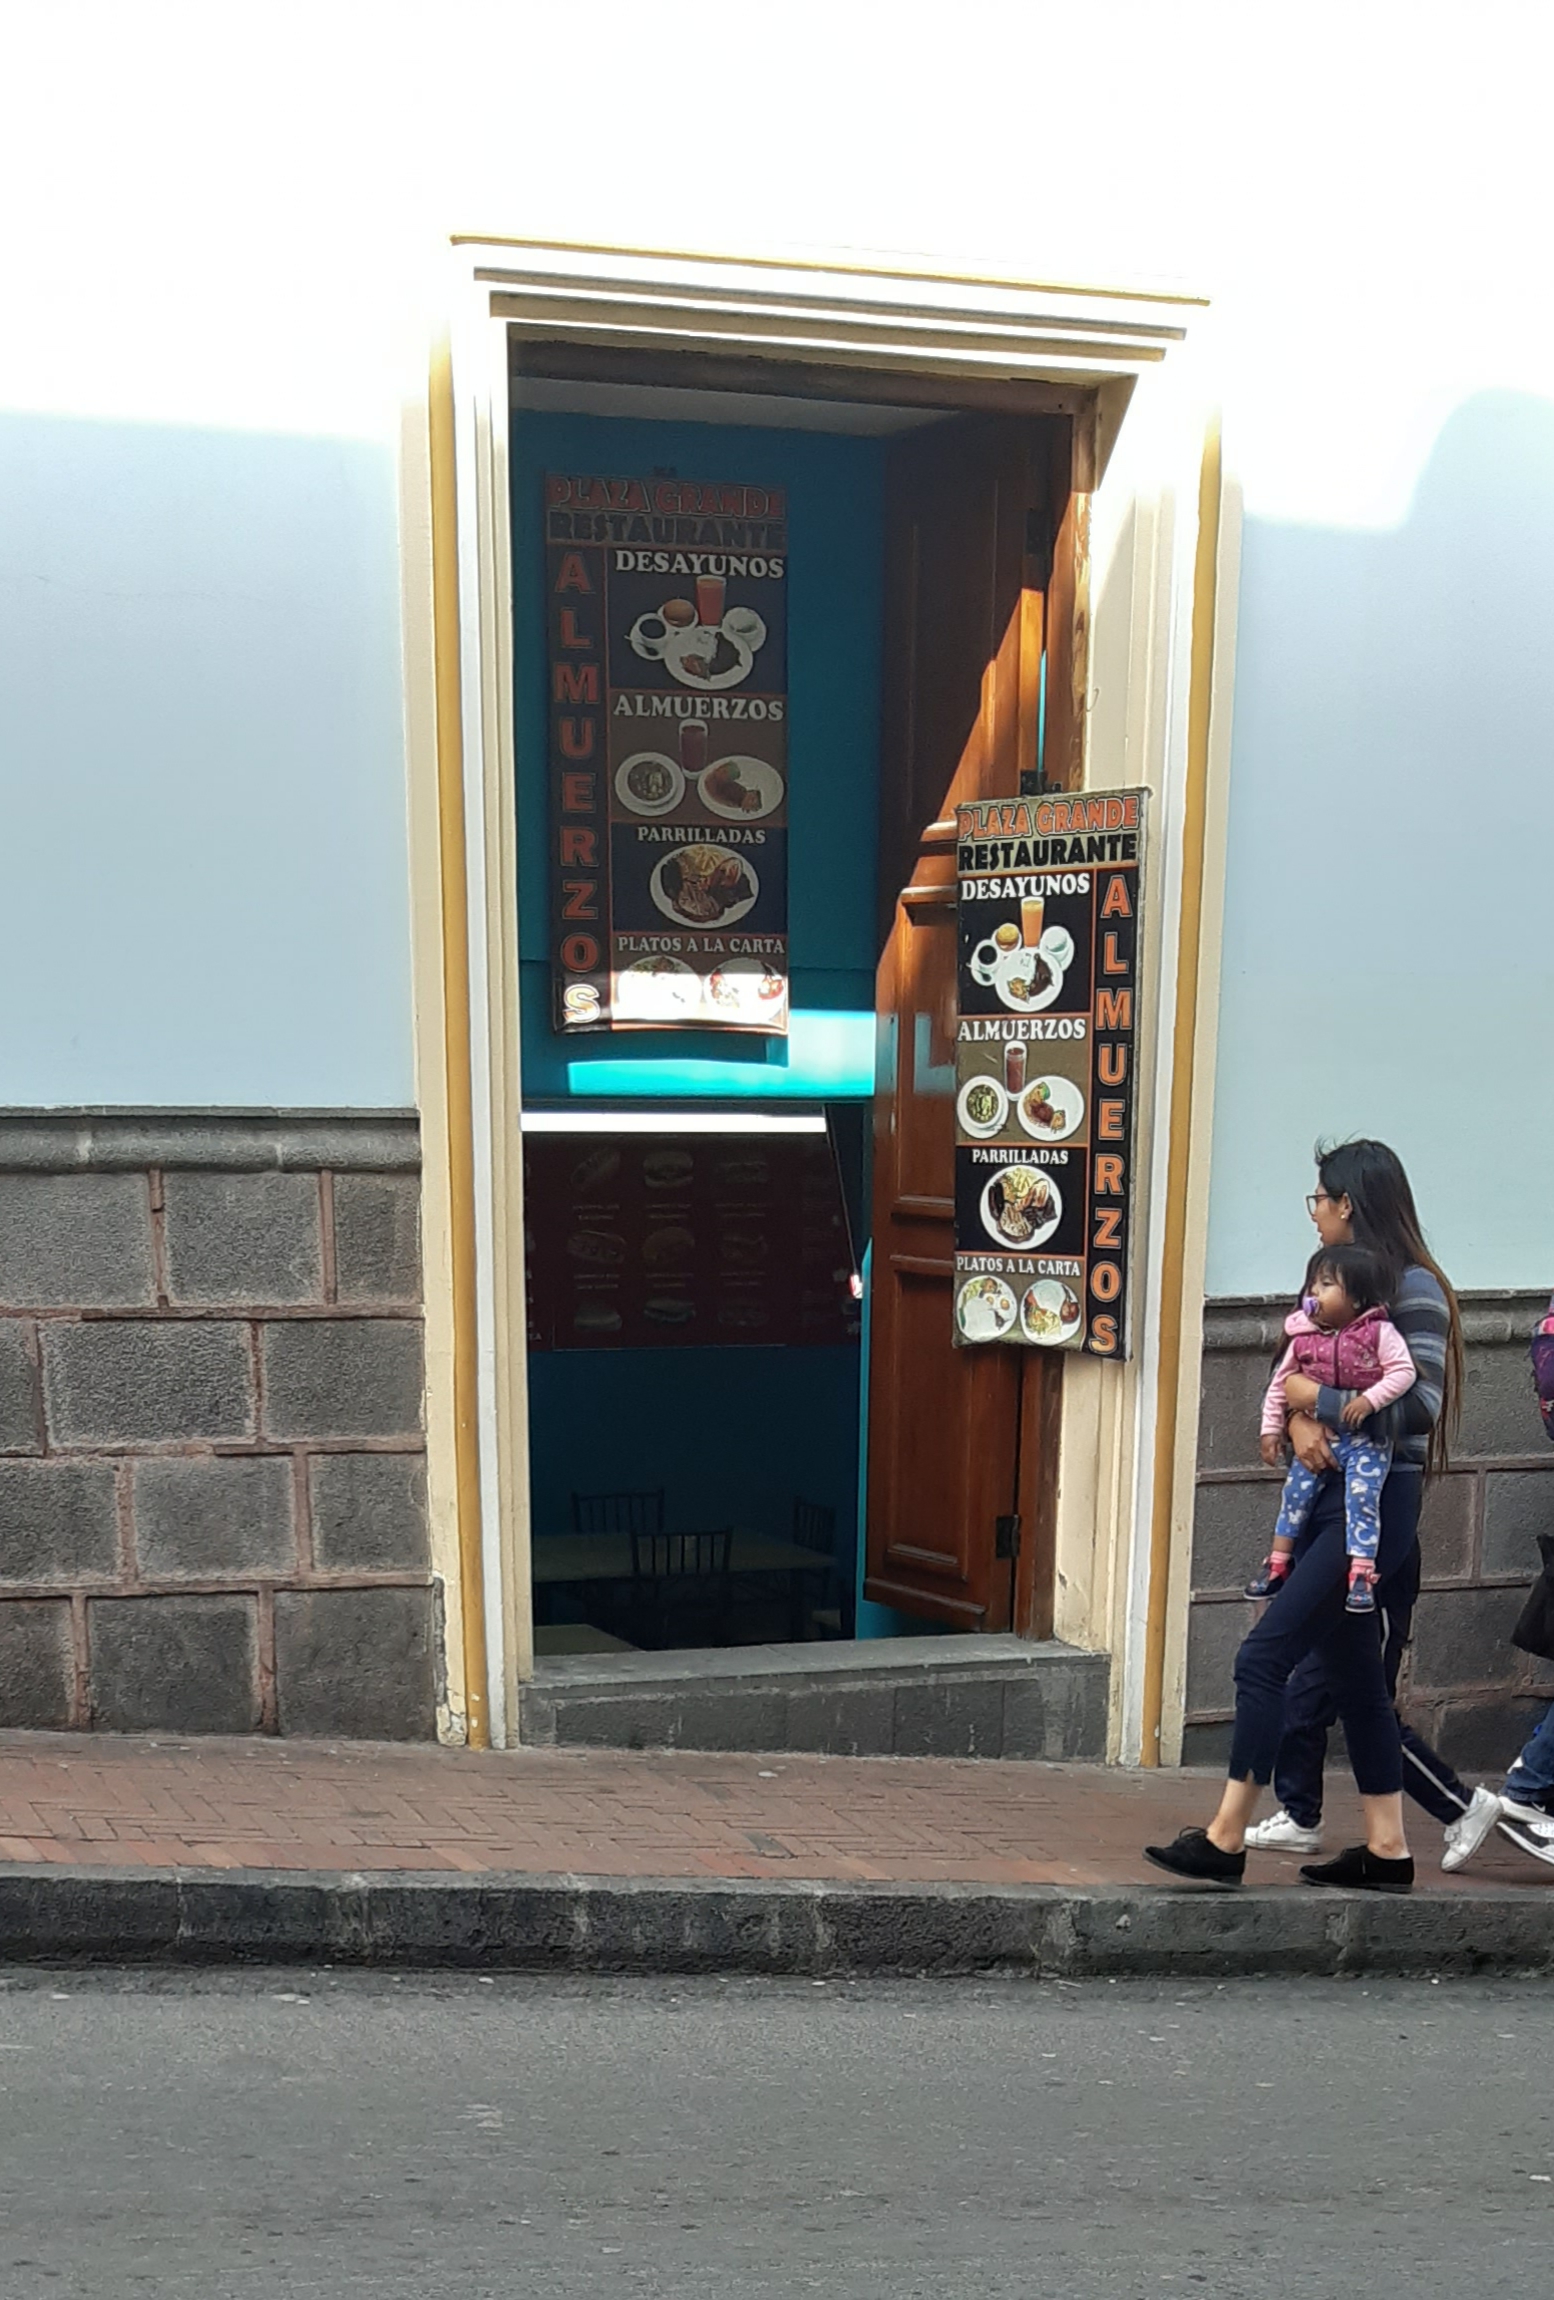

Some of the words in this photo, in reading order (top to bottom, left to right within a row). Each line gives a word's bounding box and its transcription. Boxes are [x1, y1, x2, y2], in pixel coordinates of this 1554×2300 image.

[549, 476, 650, 513] PLAZA
[655, 482, 786, 519] GRANDE
[549, 512, 788, 548] RESTAURANTE
[616, 550, 785, 578] DESAYUNOS
[613, 694, 785, 721] ALMUERZOS
[554, 552, 601, 1022] ALMUERZOS
[958, 804, 1032, 842] PLAZA
[1036, 795, 1139, 837] GRANDE
[637, 826, 766, 844] PARRILLADAS
[958, 833, 1138, 871] RESTAURANTE
[961, 873, 1090, 901] DESAYUNOS
[617, 936, 682, 952] PLATOS
[686, 937, 699, 952] A
[703, 938, 725, 952] LA
[730, 938, 785, 953] CARTA
[957, 1018, 1086, 1042] ALMUERZOS
[1090, 875, 1133, 1354] ALMUERZOS
[972, 1149, 1069, 1165] PARRILLADAS
[956, 1256, 1003, 1273] PLATOS
[1006, 1258, 1015, 1272] A
[1018, 1259, 1035, 1274] LA
[1038, 1260, 1081, 1277] CARTA
